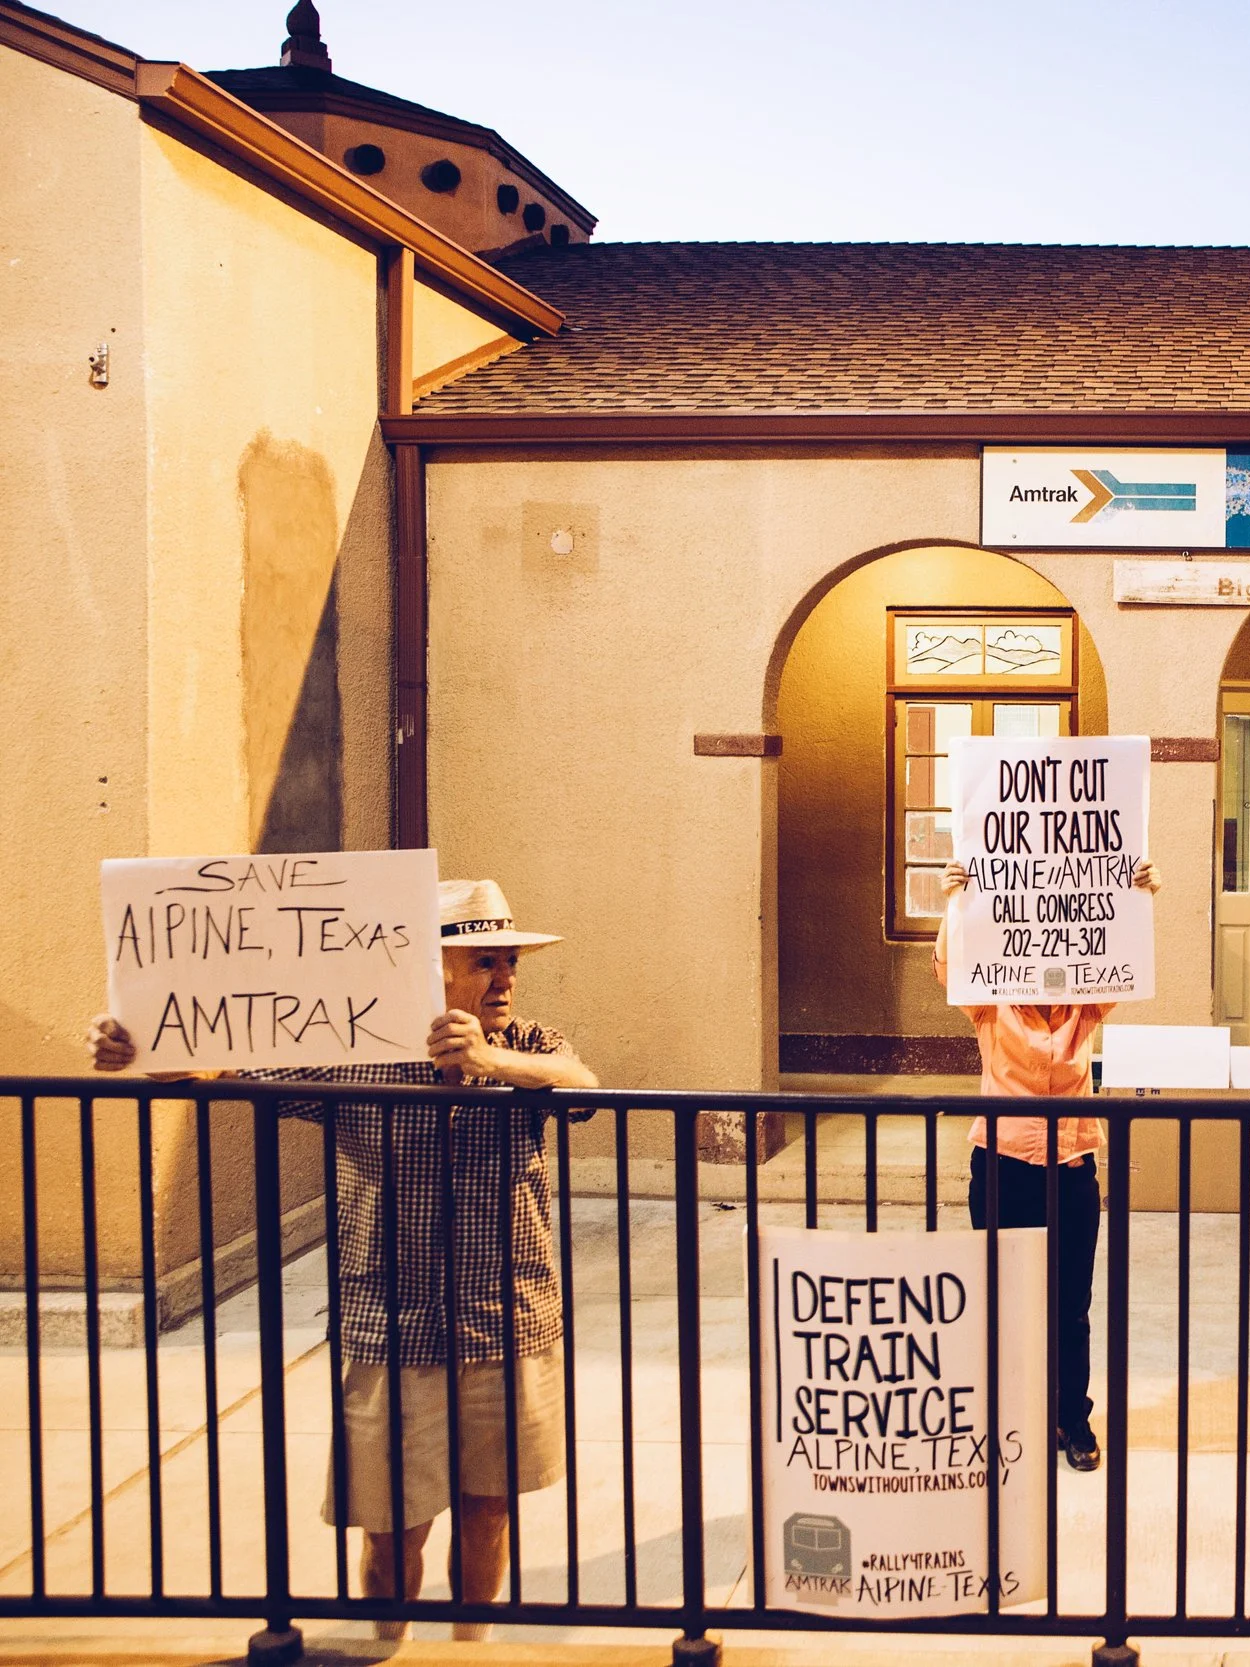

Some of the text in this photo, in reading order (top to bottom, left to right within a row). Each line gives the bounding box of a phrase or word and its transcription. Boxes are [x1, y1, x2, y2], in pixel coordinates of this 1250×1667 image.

[1009, 485, 1078, 503] Amtrak
[999, 756, 1109, 803] DON'T CUT
[984, 810, 1122, 854] OUR TRAINS
[155, 860, 347, 894] SAVE
[993, 893, 1115, 923] CALL CONGRESS
[277, 907, 411, 967] TEXAS
[456, 921, 498, 934] TEXAS
[1003, 927, 1106, 957] 202-224-3121
[971, 962, 1134, 986] ALPINE TEXAS
[151, 991, 409, 1056] AMTRAK
[791, 1270, 966, 1325] DEFEND
[793, 1331, 941, 1383] TRAIN
[792, 1386, 974, 1438] SERVICE
[786, 1436, 920, 1473] ALPINE,
[813, 1470, 990, 1493] TOWNSWITHOUTTRAINS.CO
[862, 1551, 966, 1572] #RALLY4TRAINS
[785, 1574, 851, 1594] AMTRAK
